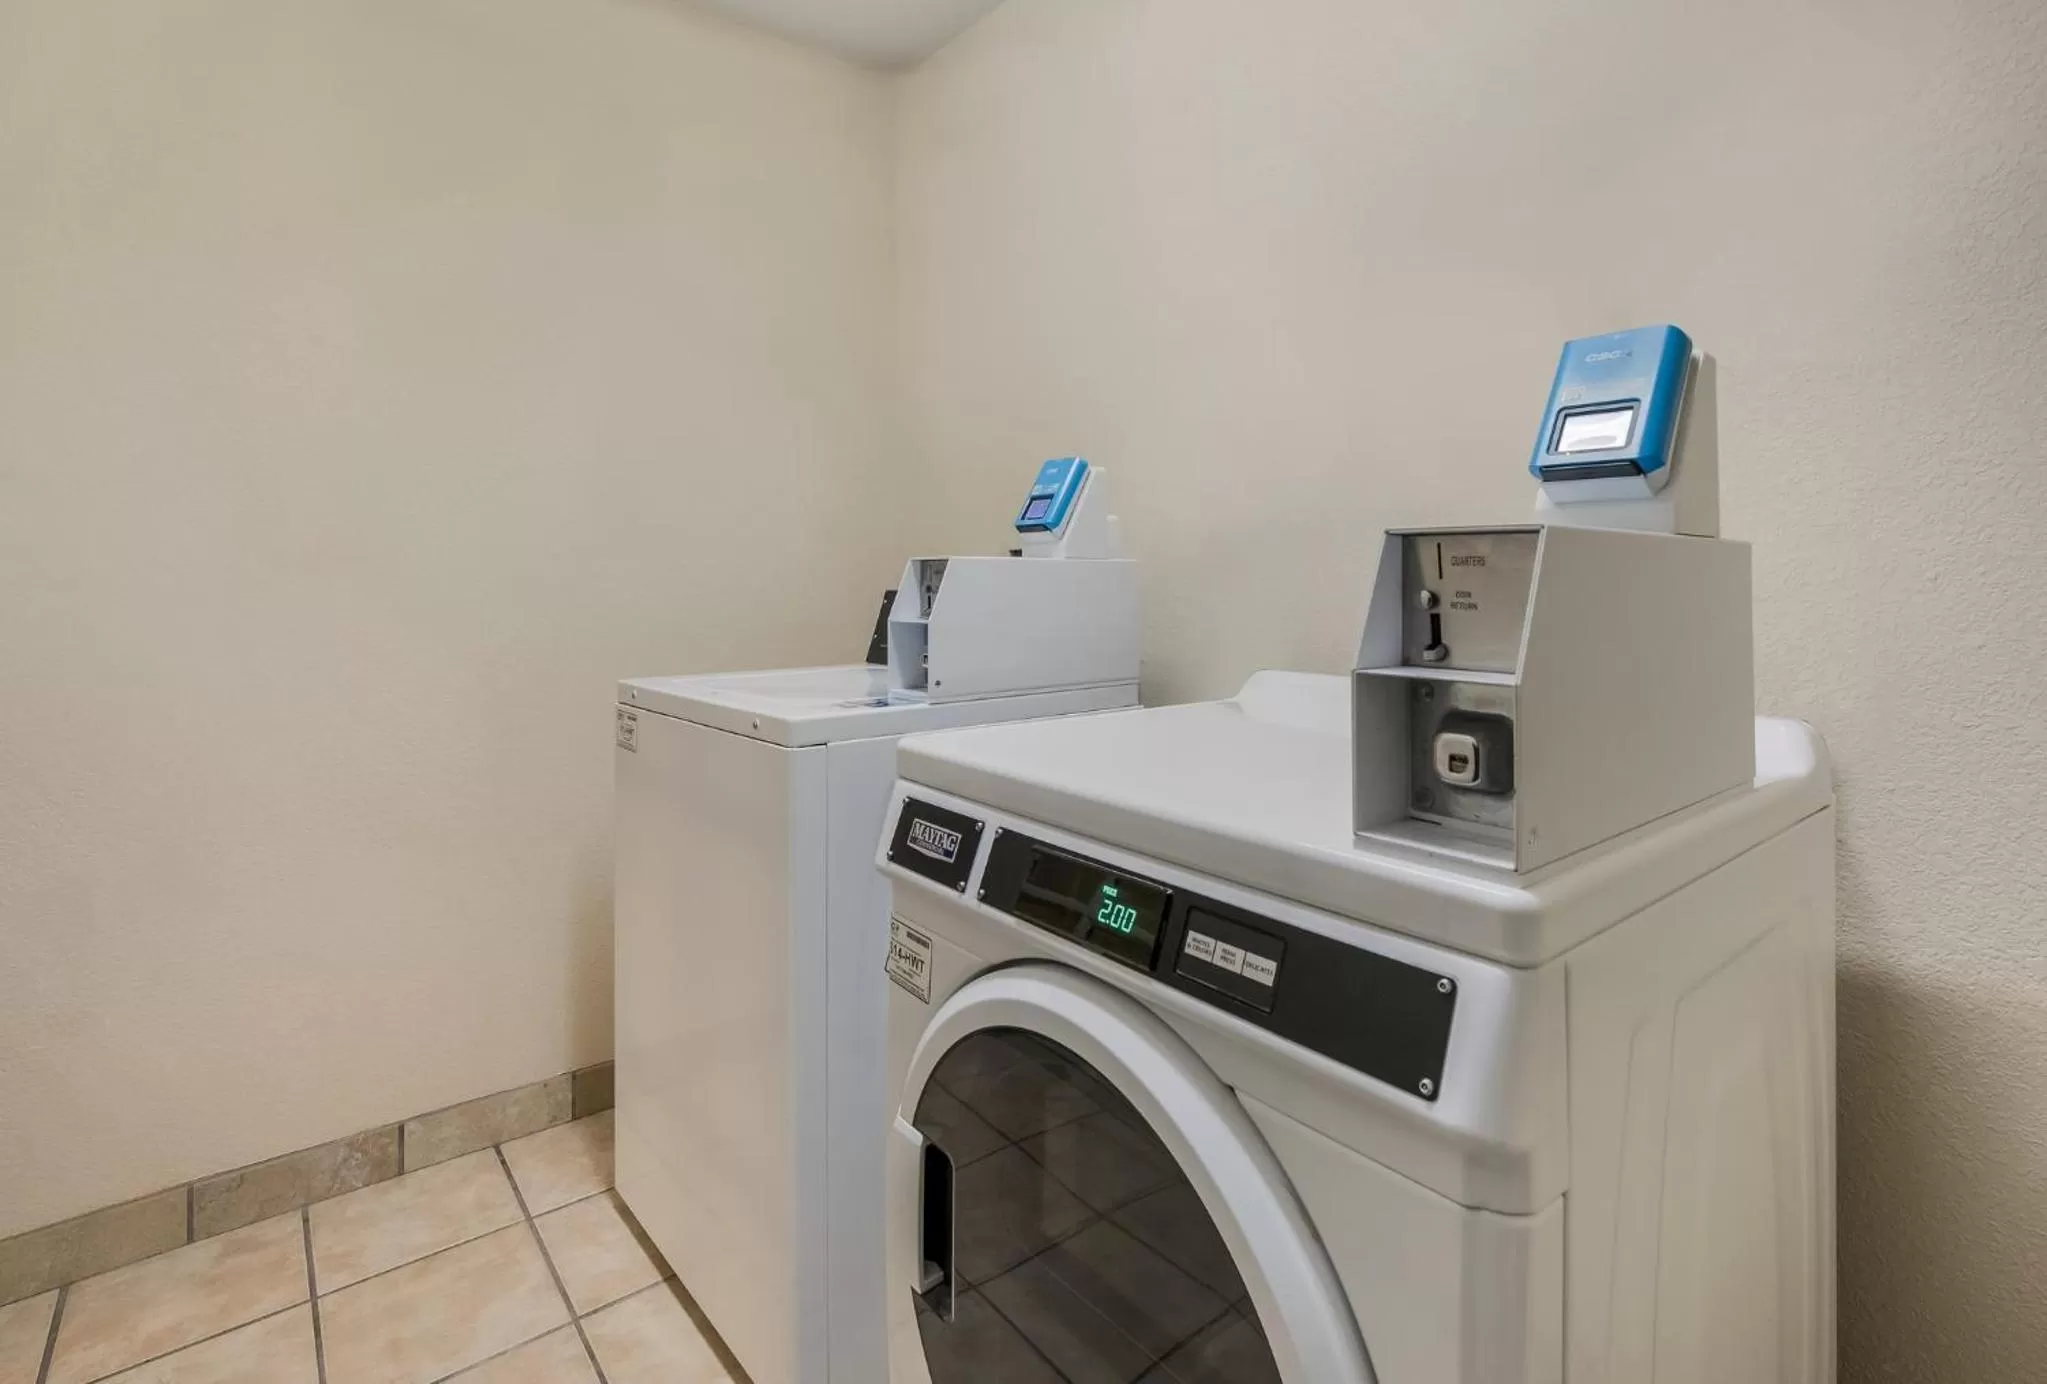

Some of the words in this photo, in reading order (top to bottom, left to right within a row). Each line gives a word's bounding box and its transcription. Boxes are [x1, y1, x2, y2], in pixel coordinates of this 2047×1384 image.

[1450, 556, 1486, 567] QUARTERS
[911, 822, 957, 852] MAYTAG
[1098, 899, 1136, 933] 2.00
